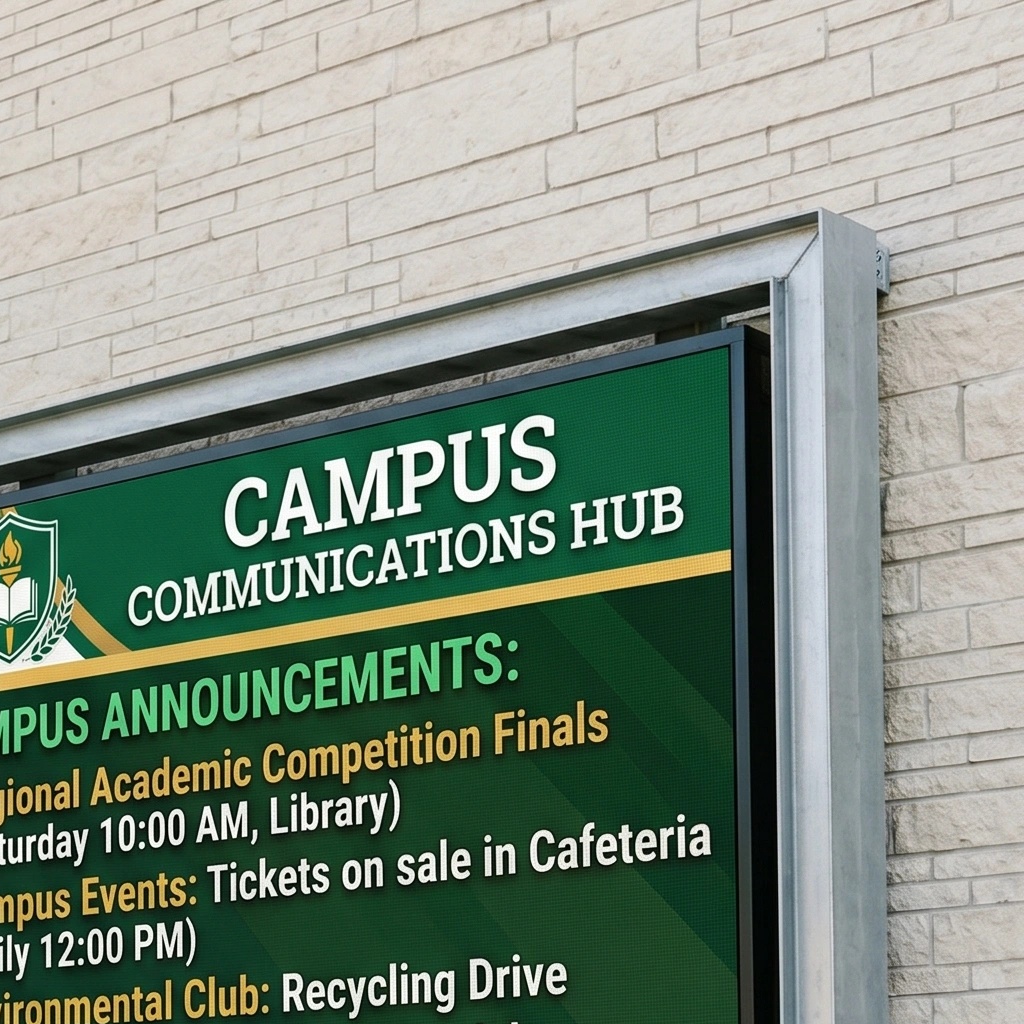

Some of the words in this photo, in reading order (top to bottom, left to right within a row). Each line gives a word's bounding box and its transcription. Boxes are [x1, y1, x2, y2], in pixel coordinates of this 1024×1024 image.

[224, 414, 557, 548] CAMPUS
[127, 509, 556, 627] COMMUNICATIONS
[569, 485, 684, 550] HUB
[101, 632, 519, 741] ANNOUNCEMENTS:
[89, 748, 252, 806] Academic
[262, 720, 480, 784] Competition
[494, 700, 609, 755] Finals
[82, 874, 198, 916] Events:
[206, 858, 330, 903] Tickets
[341, 856, 384, 891] on
[396, 838, 472, 886] sale
[483, 834, 516, 877] in
[529, 813, 712, 873] Cafeteria
[100, 808, 186, 854] 10:00
[195, 800, 259, 845] AM,
[270, 778, 401, 835] Library)
[40, 926, 124, 969] 12:00
[134, 916, 197, 967] PM)
[184, 974, 270, 1019] Club:
[282, 962, 455, 1020] Recycling
[469, 953, 568, 1001] Drive
